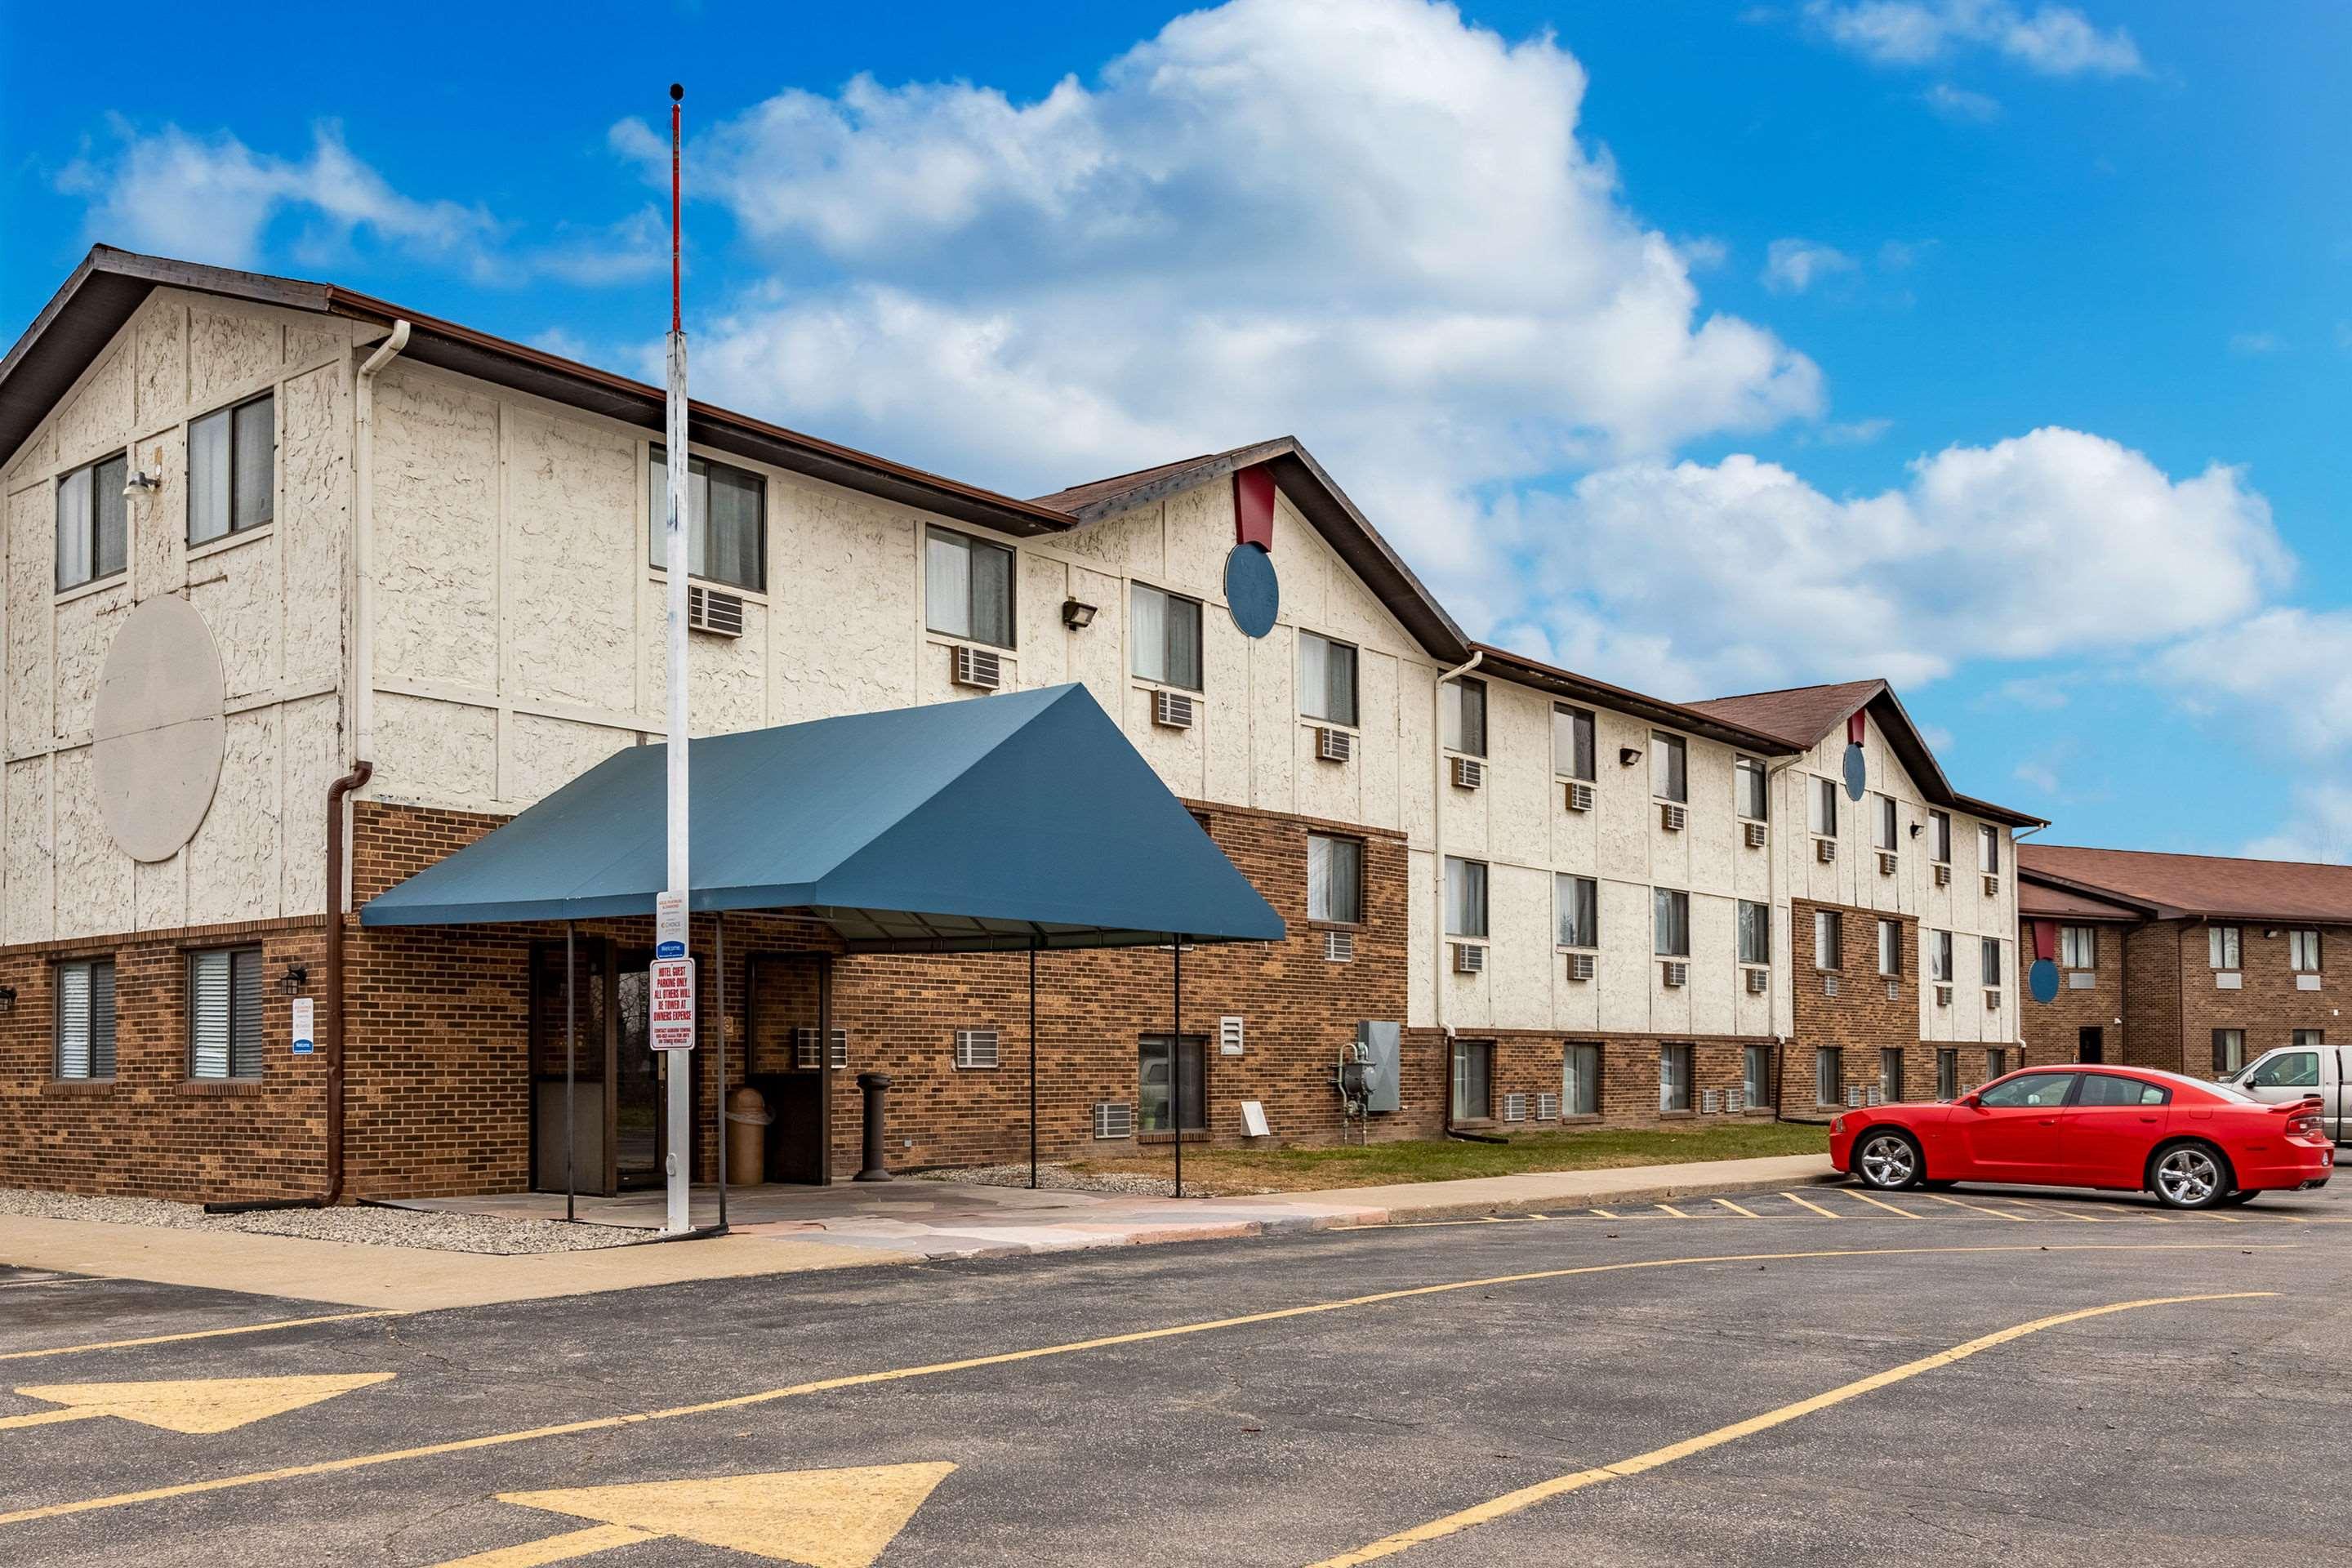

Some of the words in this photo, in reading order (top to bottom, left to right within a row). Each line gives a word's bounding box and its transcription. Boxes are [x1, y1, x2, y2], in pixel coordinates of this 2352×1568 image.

[658, 967, 671, 977] HOTEL
[673, 966, 686, 977] GUEST
[657, 978, 675, 987] PARKING
[676, 977, 687, 987] ONLY
[663, 989, 679, 999] OTHERS
[680, 988, 691, 998] WILL
[658, 1000, 663, 1010] BE
[665, 1000, 679, 1009] TOWED
[681, 999, 686, 1009] AT
[654, 1012, 671, 1021] OWNERS
[673, 1011, 691, 1020] EXPENSE
